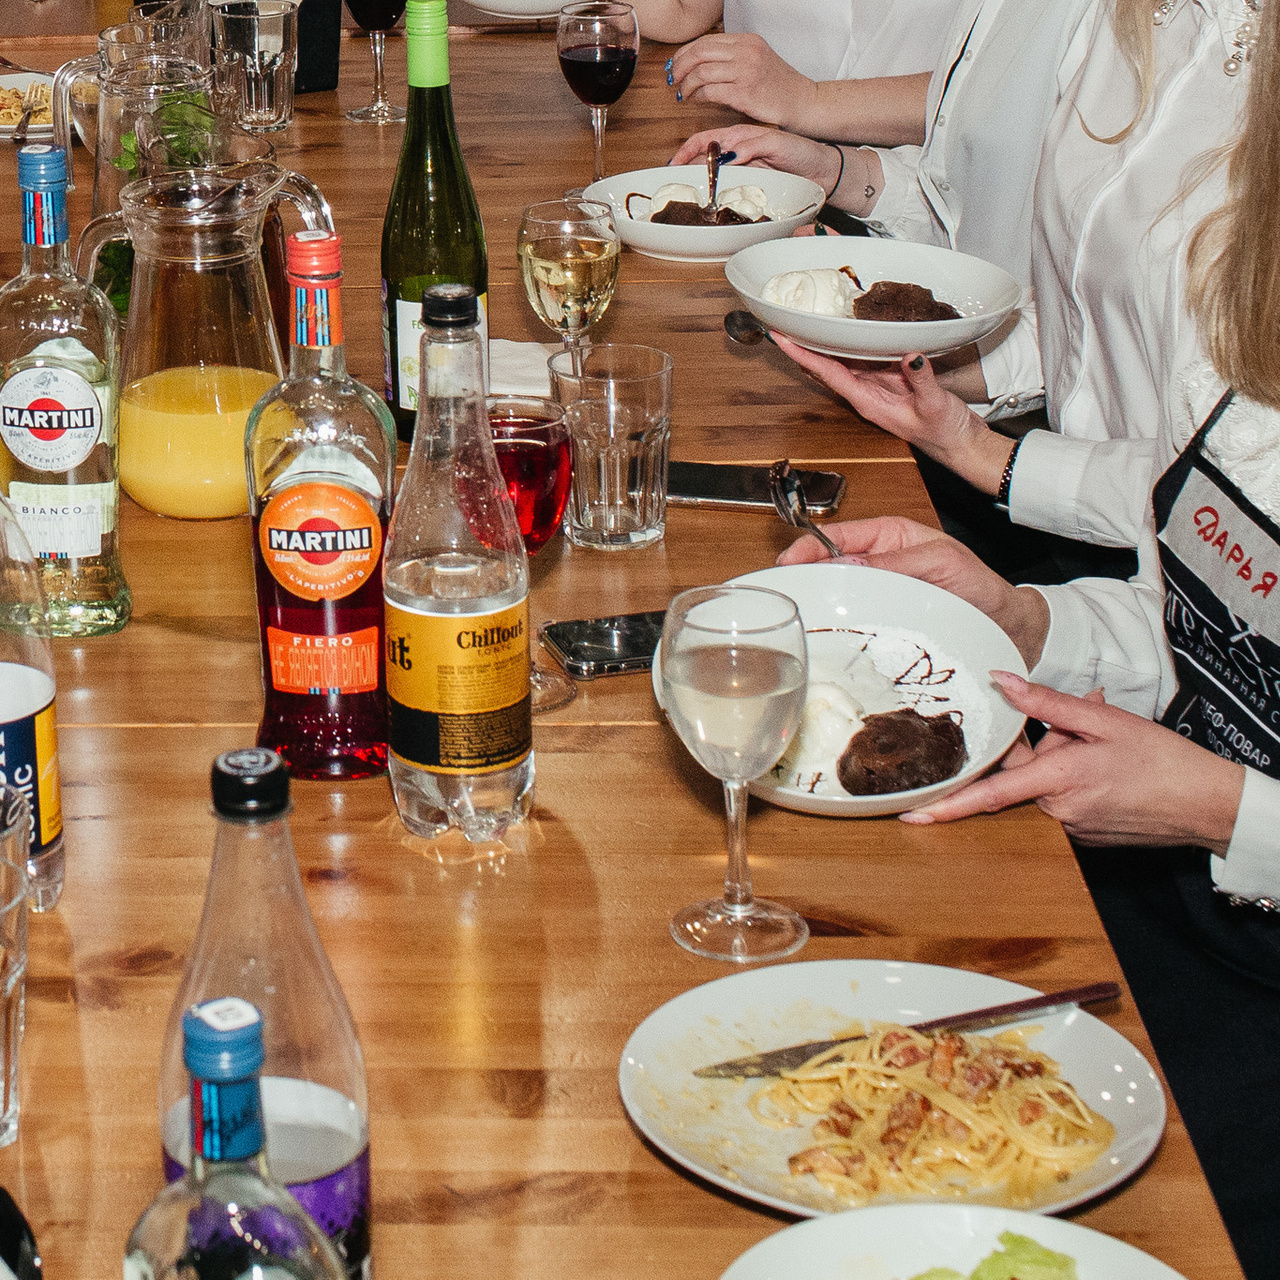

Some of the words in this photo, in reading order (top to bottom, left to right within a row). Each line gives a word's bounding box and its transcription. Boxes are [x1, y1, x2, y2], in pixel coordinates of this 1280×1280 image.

[4, 407, 91, 429] MARTINI
[21, 506, 82, 515] BIANCO
[270, 528, 370, 552] MARTINI
[1193, 506, 1279, 599] ДАРЬЯ
[293, 636, 353, 648] FIERO
[456, 618, 524, 650] Chillout
[1177, 634, 1267, 711] КУЛИНАРНАЯ
